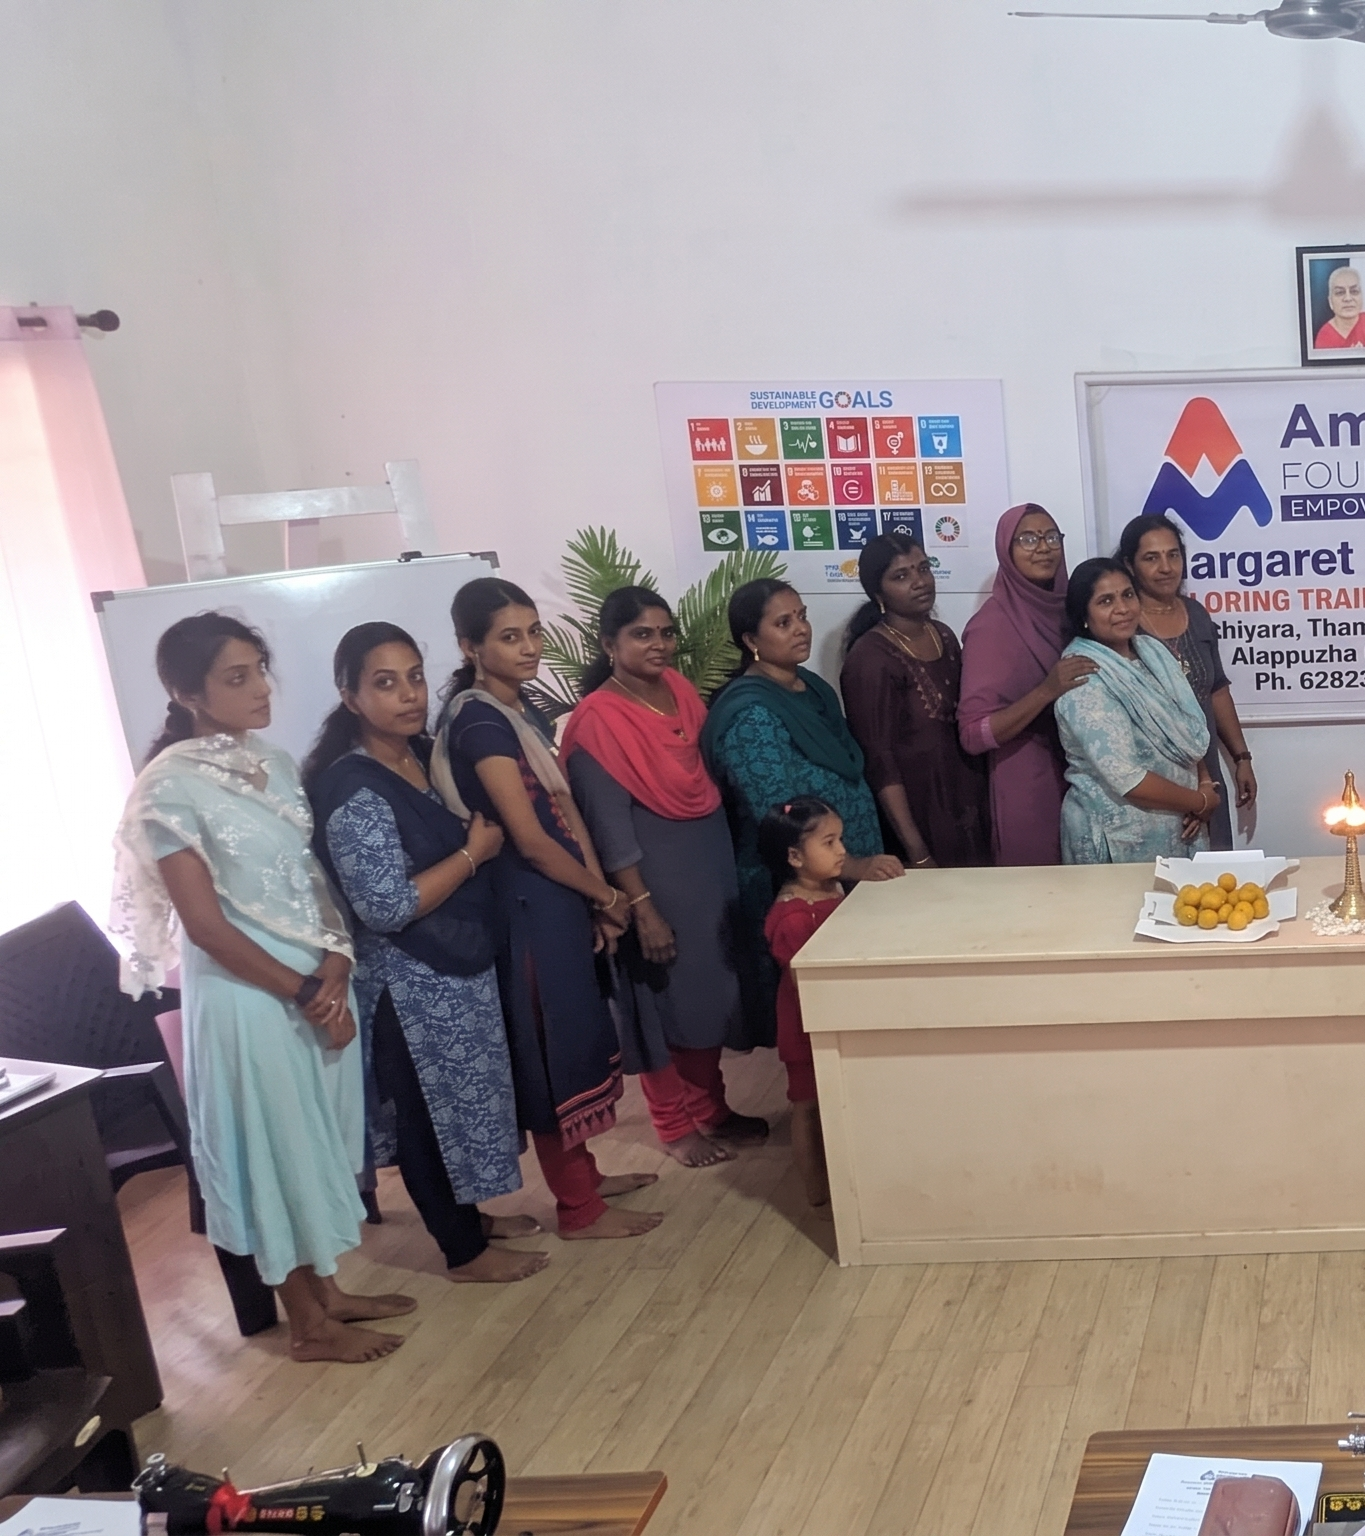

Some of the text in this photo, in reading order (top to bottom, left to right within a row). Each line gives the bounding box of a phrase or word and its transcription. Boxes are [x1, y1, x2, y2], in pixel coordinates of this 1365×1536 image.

[750, 391, 816, 400] SUSTAINABLE
[819, 390, 893, 409] GOALS
[751, 401, 817, 409] DEVELOPMENT
[1190, 589, 1291, 614] ORING
[1231, 644, 1357, 668] Alappuzha
[1255, 672, 1292, 690] Ph.
